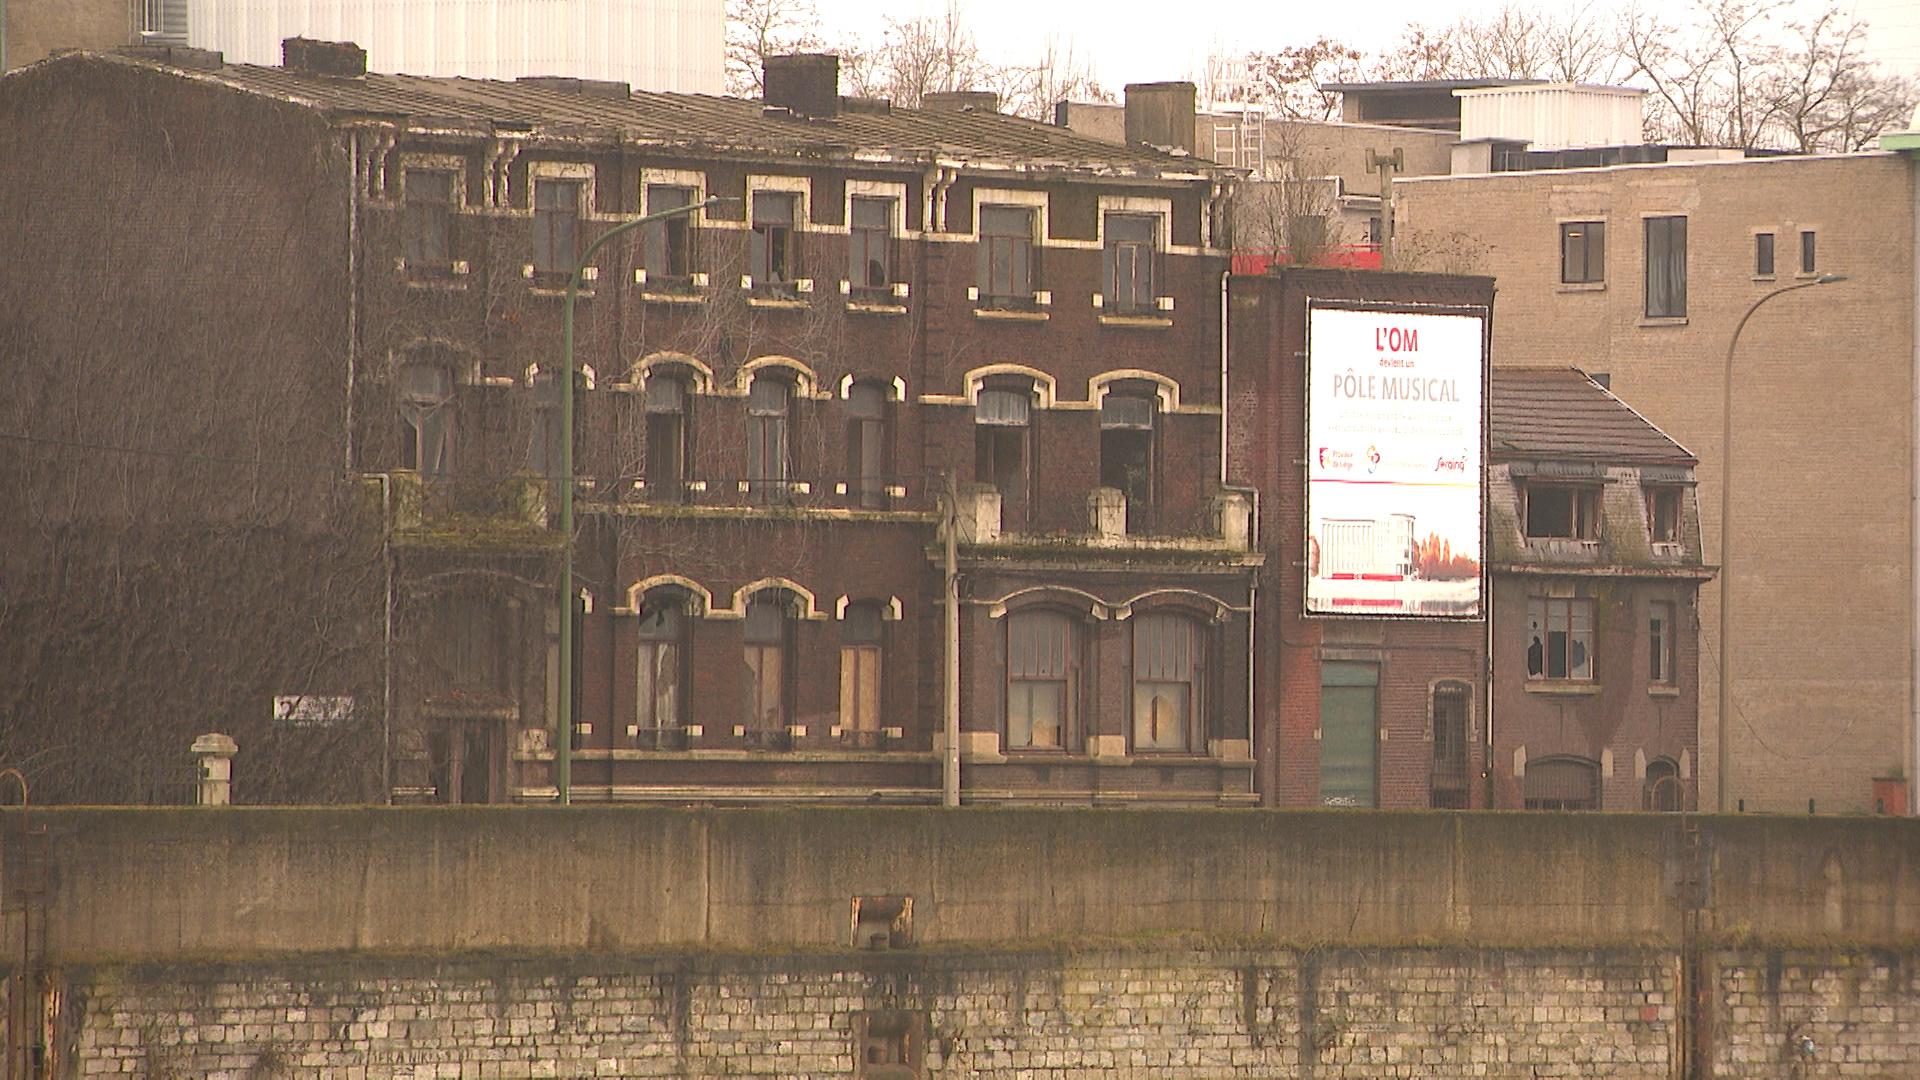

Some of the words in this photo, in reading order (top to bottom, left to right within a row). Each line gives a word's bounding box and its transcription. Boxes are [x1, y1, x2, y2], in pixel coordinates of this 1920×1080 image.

[1376, 327, 1418, 352] L'OM
[1379, 358, 1404, 368] devient
[1333, 367, 1376, 400] PÔLE
[1382, 376, 1460, 402] MUSICAL
